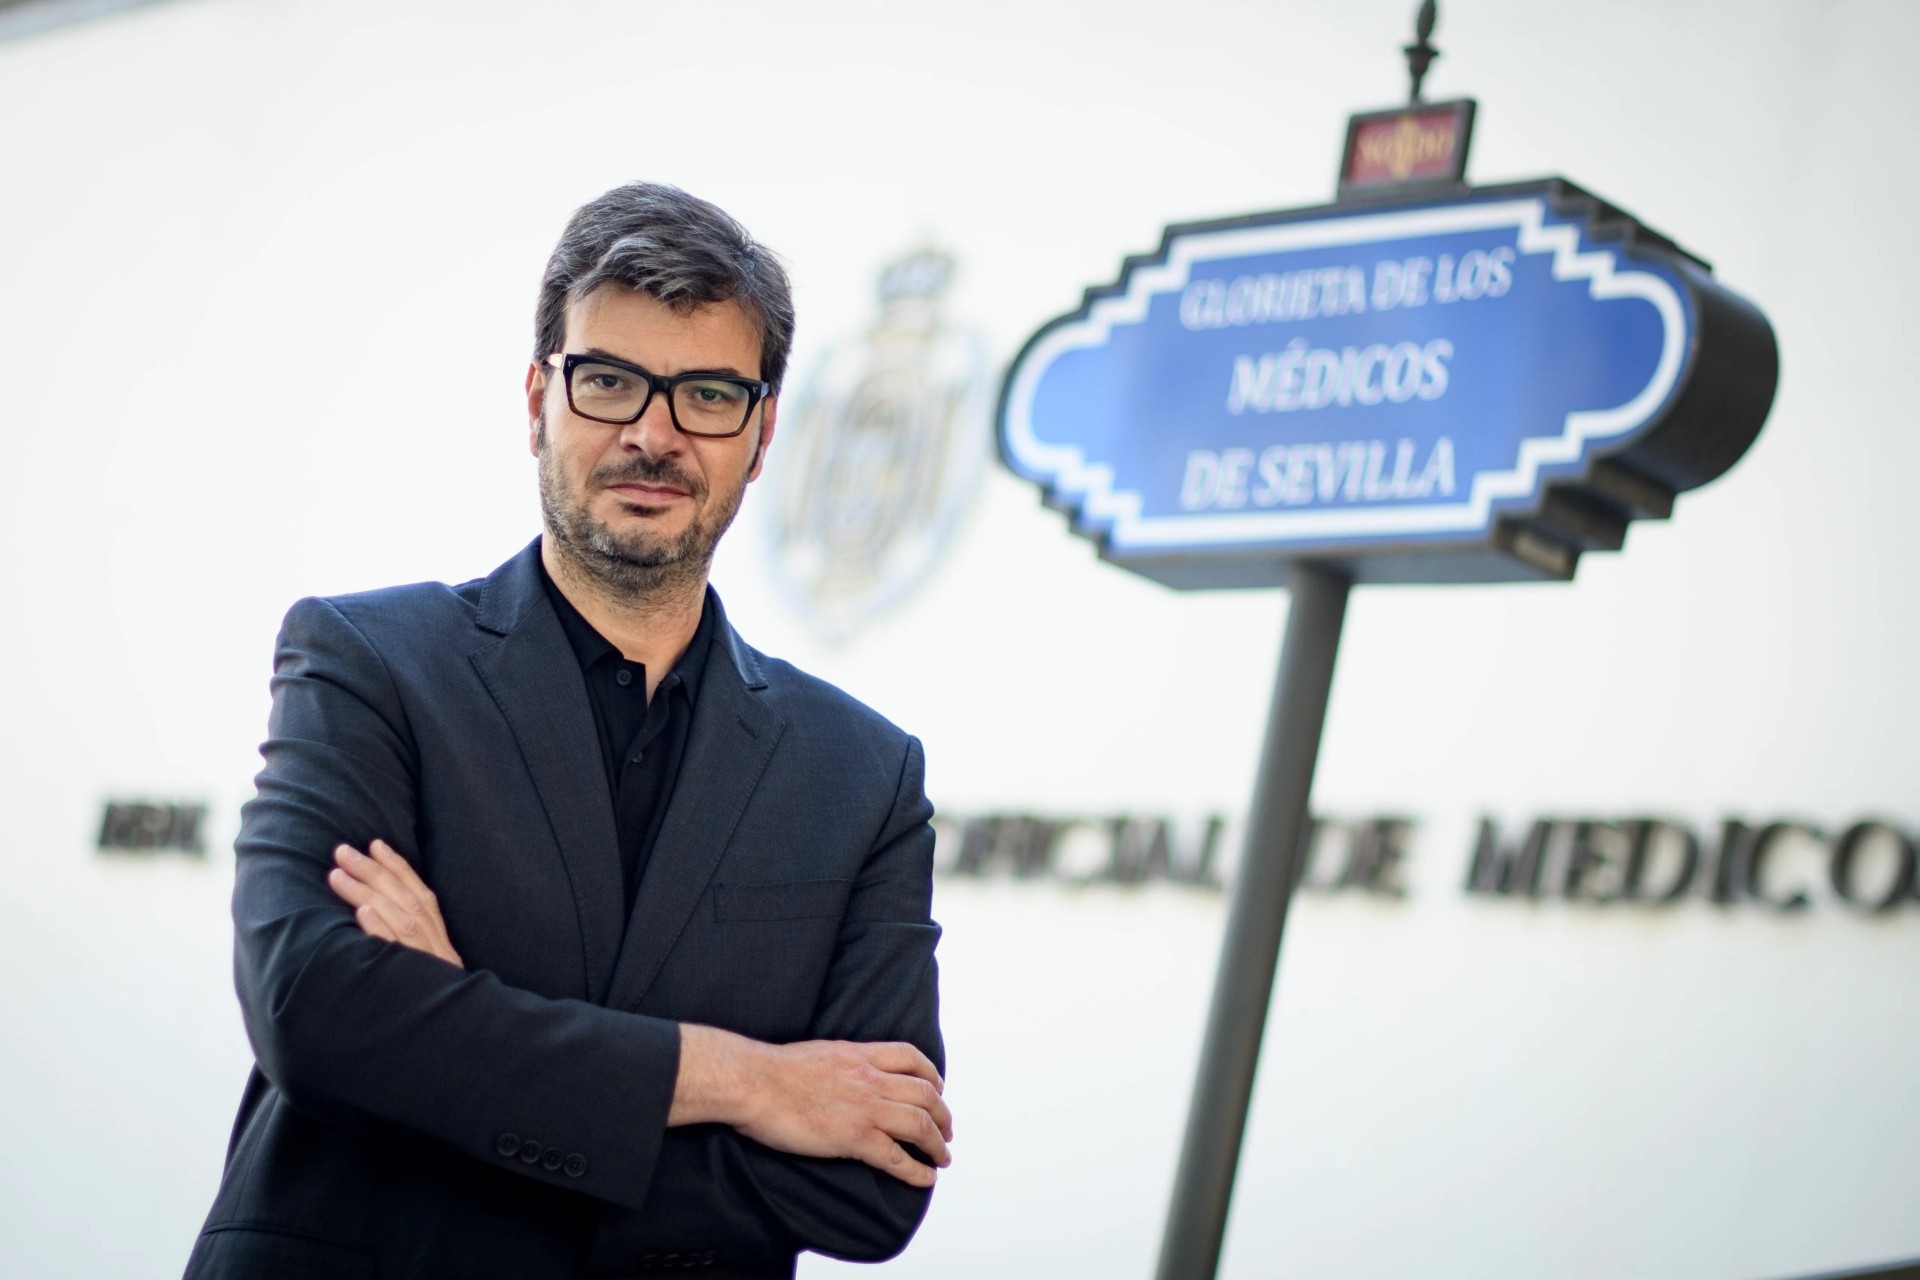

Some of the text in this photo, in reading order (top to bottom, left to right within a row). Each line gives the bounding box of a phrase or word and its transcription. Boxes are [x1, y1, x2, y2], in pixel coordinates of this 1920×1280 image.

[1179, 246, 1516, 331] GLORIETA DE LOS
[1227, 336, 1454, 415] MÉDICOS
[1180, 436, 1455, 511] DE SEVILLA
[1465, 813, 1920, 914] MEDICO
